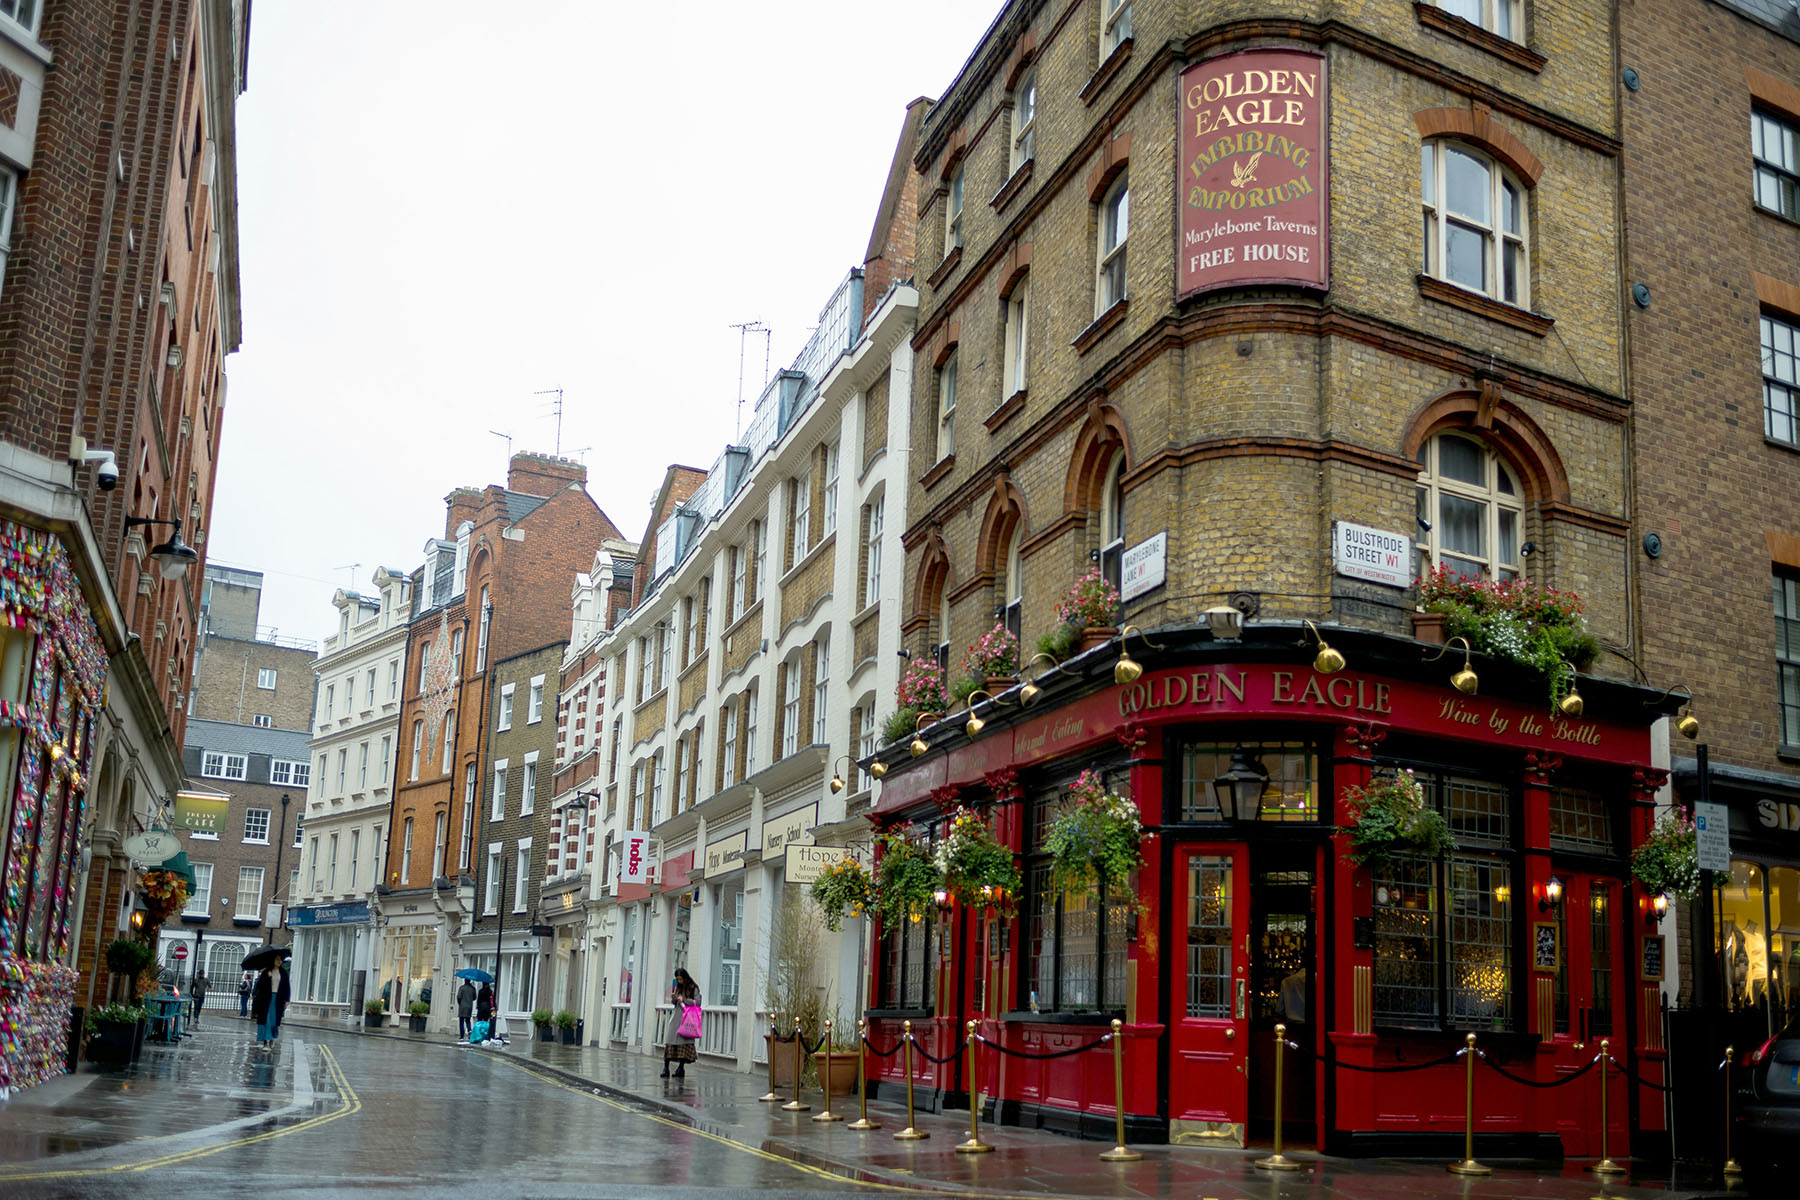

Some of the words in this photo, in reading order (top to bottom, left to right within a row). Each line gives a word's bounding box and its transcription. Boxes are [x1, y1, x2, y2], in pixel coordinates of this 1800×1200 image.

[1186, 69, 1316, 110] GOLDEN
[1194, 99, 1306, 138] EAGLE
[1190, 130, 1312, 180] IMBIBING
[1187, 175, 1315, 212] EMPORIUM
[1185, 218, 1262, 247] Marylebone
[1263, 215, 1317, 236] Taverns
[1190, 245, 1235, 273] FREE
[1243, 243, 1309, 264] HOUSE
[1125, 539, 1160, 569] MARYLEBONE
[1345, 528, 1403, 553] BULSTRODE
[1345, 544, 1382, 564] STREET
[1385, 553, 1399, 568] W1
[1124, 567, 1137, 584] LANE
[1138, 562, 1146, 576] W1
[1118, 671, 1248, 718] GOLDEN
[1271, 671, 1393, 715] EAGLE
[1437, 695, 1481, 726] Wine
[1488, 708, 1511, 735] by
[1518, 714, 1543, 737] the
[1551, 718, 1602, 746] Bottle
[628, 838, 644, 876] hobs
[799, 848, 840, 864] Hope
